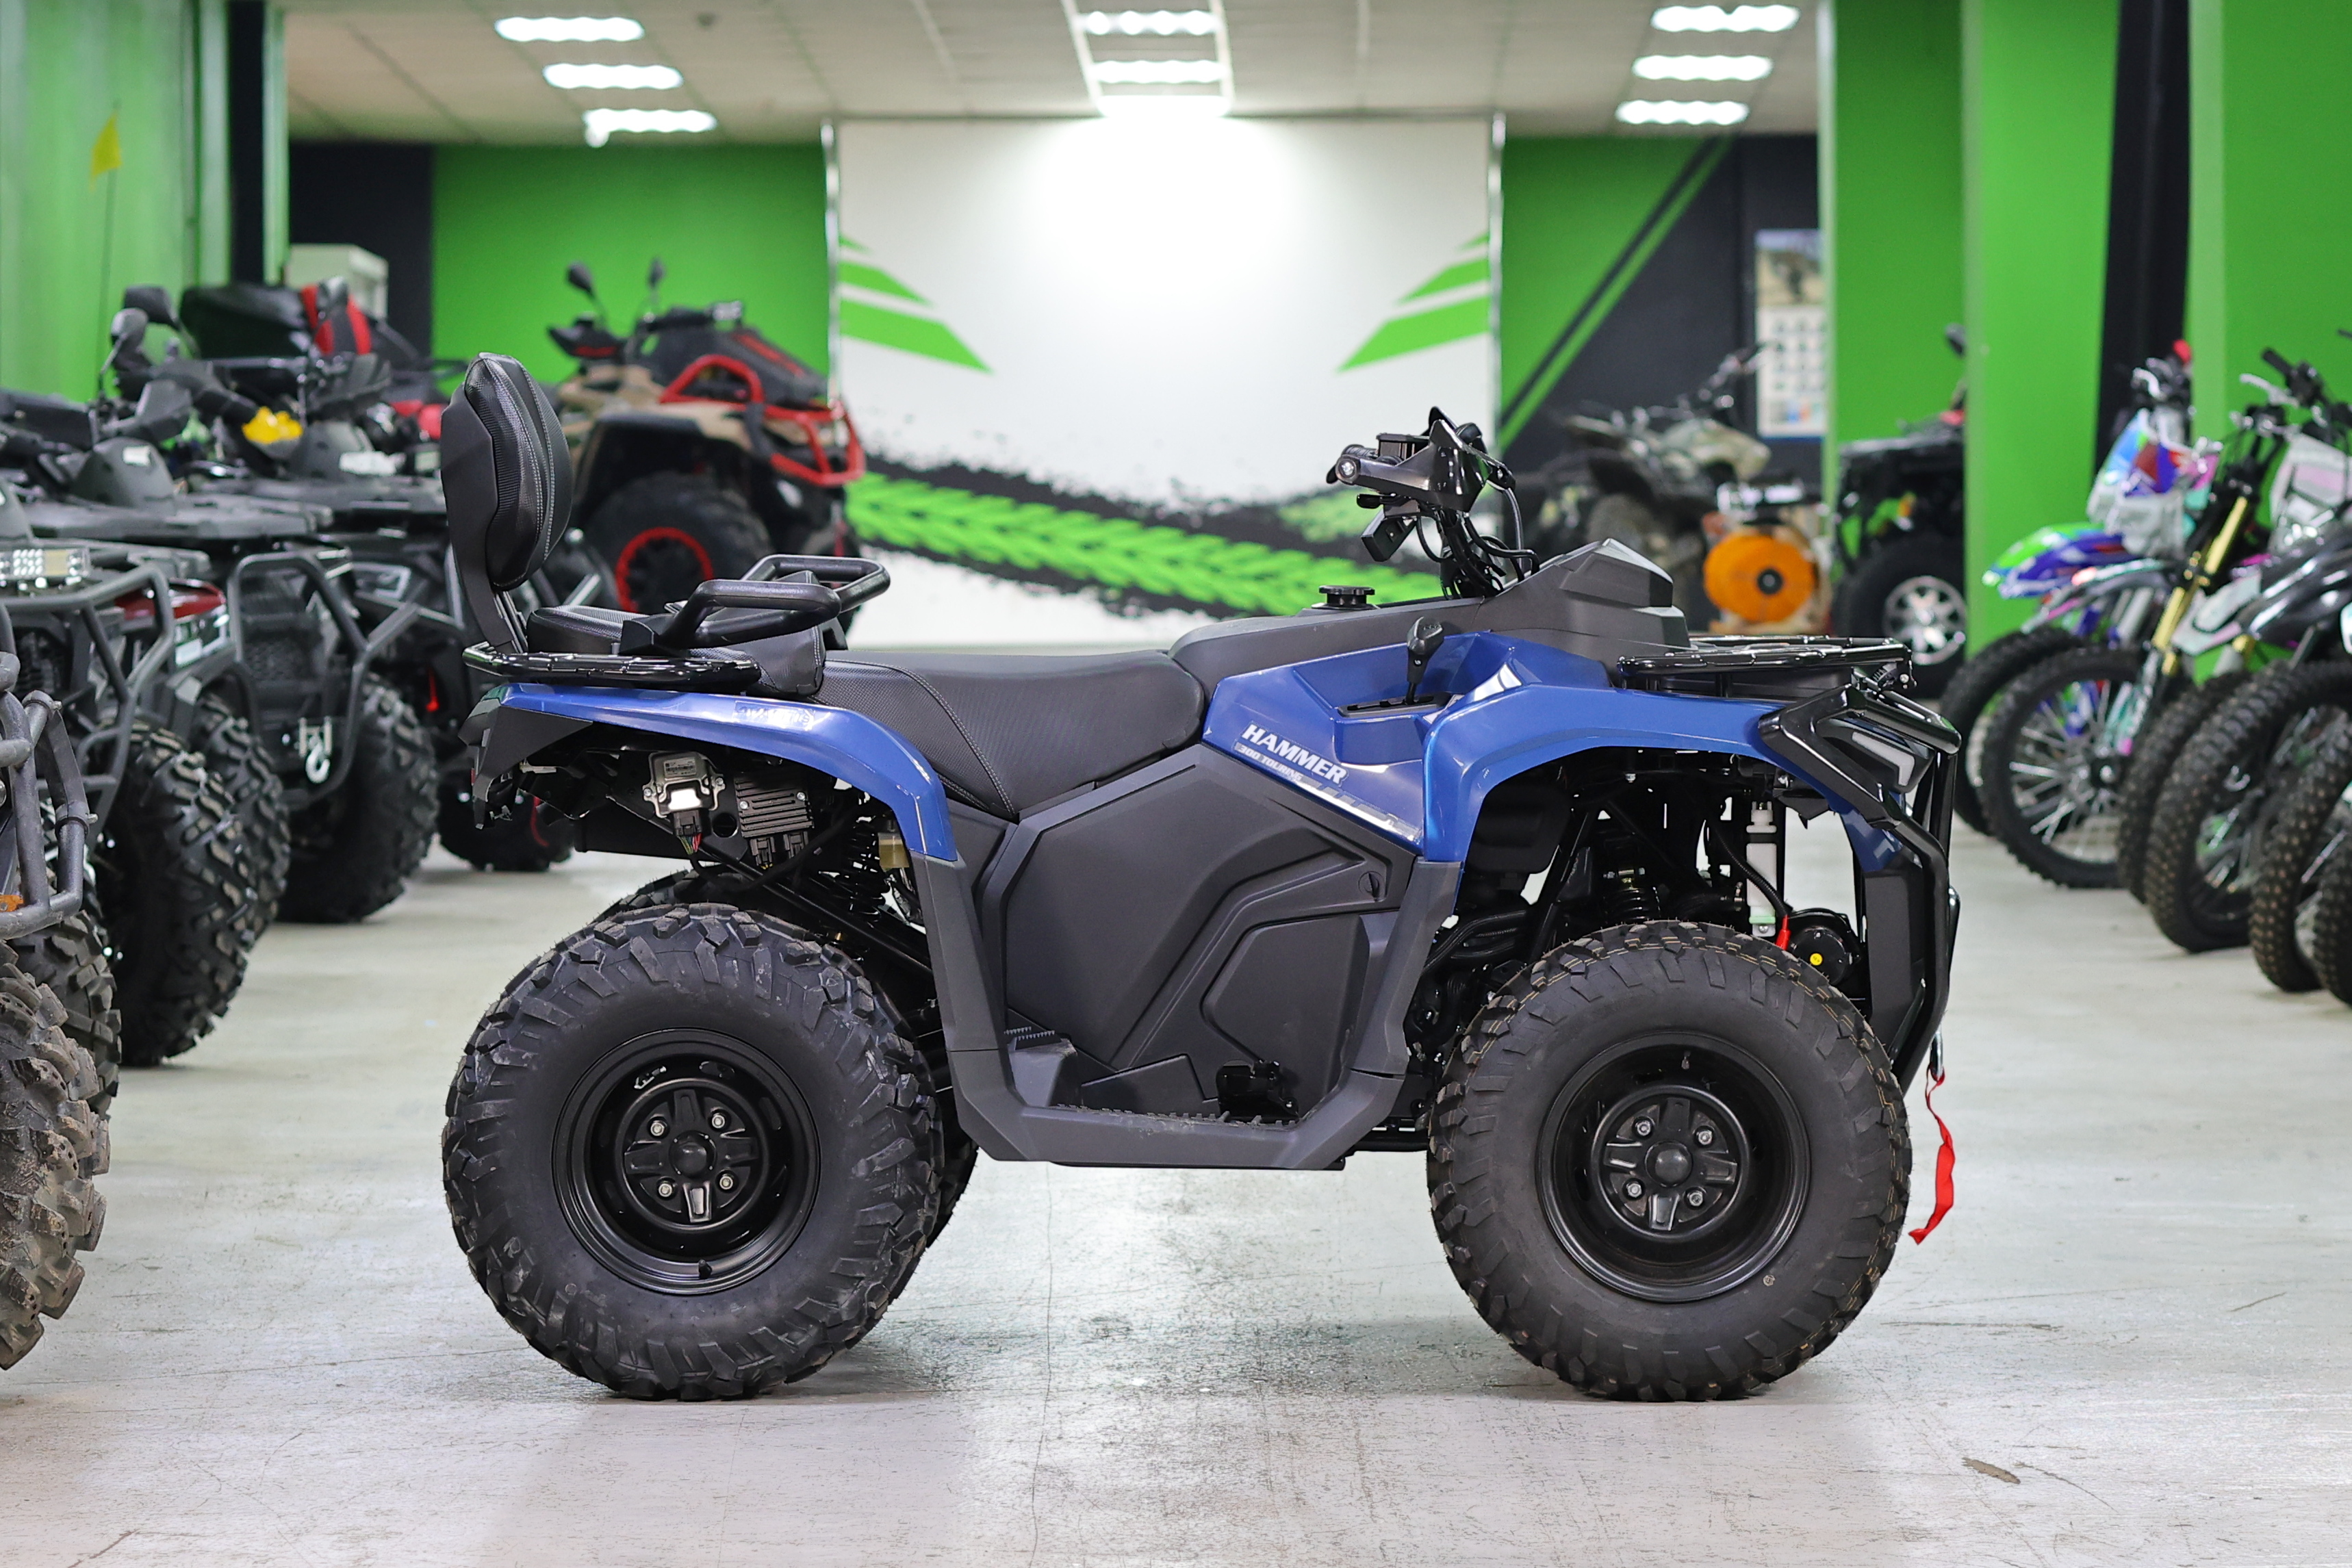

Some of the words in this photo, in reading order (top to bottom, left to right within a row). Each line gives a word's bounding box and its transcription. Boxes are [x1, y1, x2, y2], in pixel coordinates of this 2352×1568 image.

[1239, 744, 1260, 760] 300
[1260, 754, 1304, 782] TOURING
[1241, 723, 1348, 784] HAMMER
